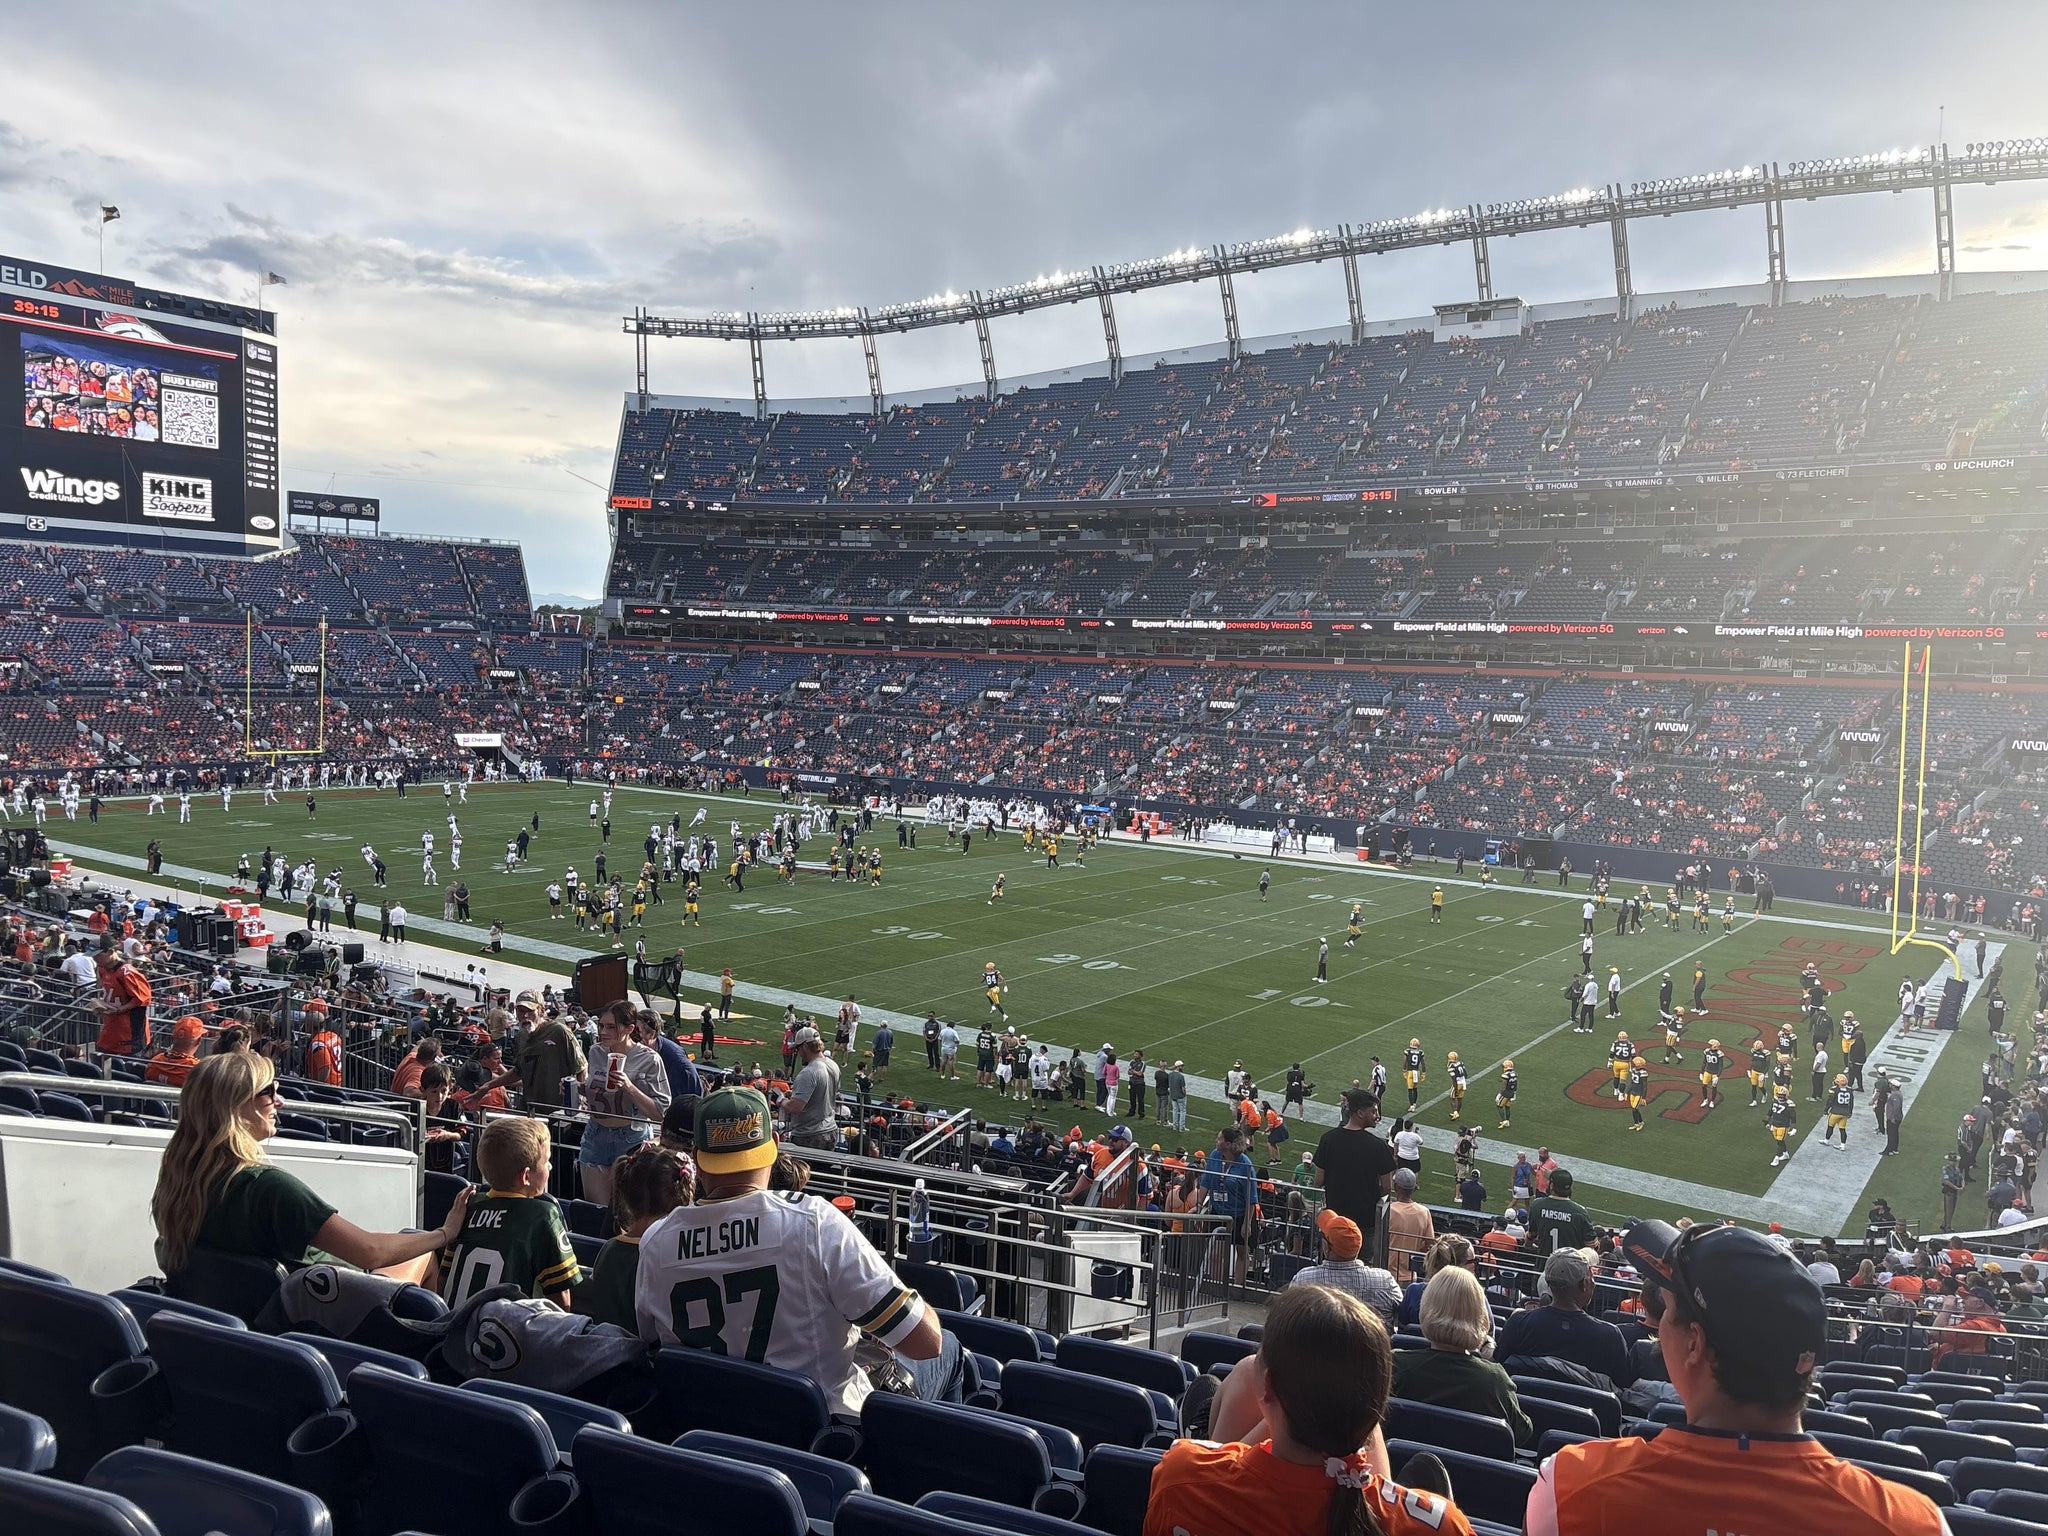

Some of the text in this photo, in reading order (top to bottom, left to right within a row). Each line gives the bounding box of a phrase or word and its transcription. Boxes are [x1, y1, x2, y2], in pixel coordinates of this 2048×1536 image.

[1, 265, 47, 289] ELD
[109, 286, 133, 298] MILE
[109, 295, 135, 306] HIGH
[14, 300, 59, 318] 39:15
[164, 376, 215, 390] BUD LIGHT
[1935, 459, 2015, 471] 80 UPCHURCH
[1706, 475, 1739, 483] MILLER
[1787, 469, 1845, 479] 73 FLETCHER
[21, 468, 119, 505] Wings
[1547, 482, 1578, 490] THOMAS
[1625, 479, 1663, 487] MANNING
[150, 479, 205, 499] KING
[1424, 487, 1457, 495] BOWLEN
[28, 491, 84, 503] Credit Union
[1322, 493, 1357, 501] KICKOFF
[1361, 491, 1392, 501] 39:15
[149, 496, 206, 515] Soopers
[29, 518, 45, 529] 25
[687, 608, 721, 617] Empower
[721, 609, 739, 617] Field
[761, 611, 777, 619] High
[838, 613, 849, 621] 5G
[908, 616, 938, 624] Empower
[938, 616, 955, 624] Field
[962, 616, 976, 624] Mile
[976, 617, 991, 626] High
[992, 618, 1020, 627] powered
[1020, 618, 1029, 627] by
[1029, 618, 1054, 626] Verizon
[1054, 618, 1065, 626] 5G
[1132, 620, 1166, 629] Empower
[1166, 620, 1184, 628] Field
[1193, 620, 1209, 629] Mile
[1209, 621, 1226, 630] High
[1226, 621, 1260, 630] powered
[1260, 621, 1270, 631] by
[1271, 621, 1299, 629] Verizon
[1300, 621, 1312, 630] 5G
[1393, 622, 1614, 635] Empower Field at Mile High powered by Verizon 5G
[1715, 626, 2004, 640] Empower Field at Mile High powered by Verizon 5G
[0, 662, 21, 670] OWER
[289, 665, 319, 673] ARROW
[1209, 701, 1235, 709] ARROW
[1355, 707, 1384, 716] ARROW
[1492, 714, 1523, 723] ARROW
[1654, 722, 1689, 732] ARROW
[1840, 731, 1881, 742] ARROW
[871, 925, 944, 940] 30
[1036, 953, 1120, 970] 20
[986, 974, 997, 985] 84
[1246, 988, 1330, 1008] 10
[980, 1039, 990, 1049] 65
[1615, 1047, 1629, 1057] 75
[1018, 1053, 1027, 1063] 10
[1411, 1054, 1419, 1066] 9
[1034, 1065, 1040, 1076] 4
[1838, 1092, 1851, 1104] 62
[468, 1209, 508, 1229] LOVE
[1541, 1208, 1572, 1222] PARSONS
[677, 1217, 759, 1260] NELSON
[1549, 1228, 1559, 1252] 1
[443, 1244, 505, 1312] 10
[670, 1265, 780, 1364] 87
